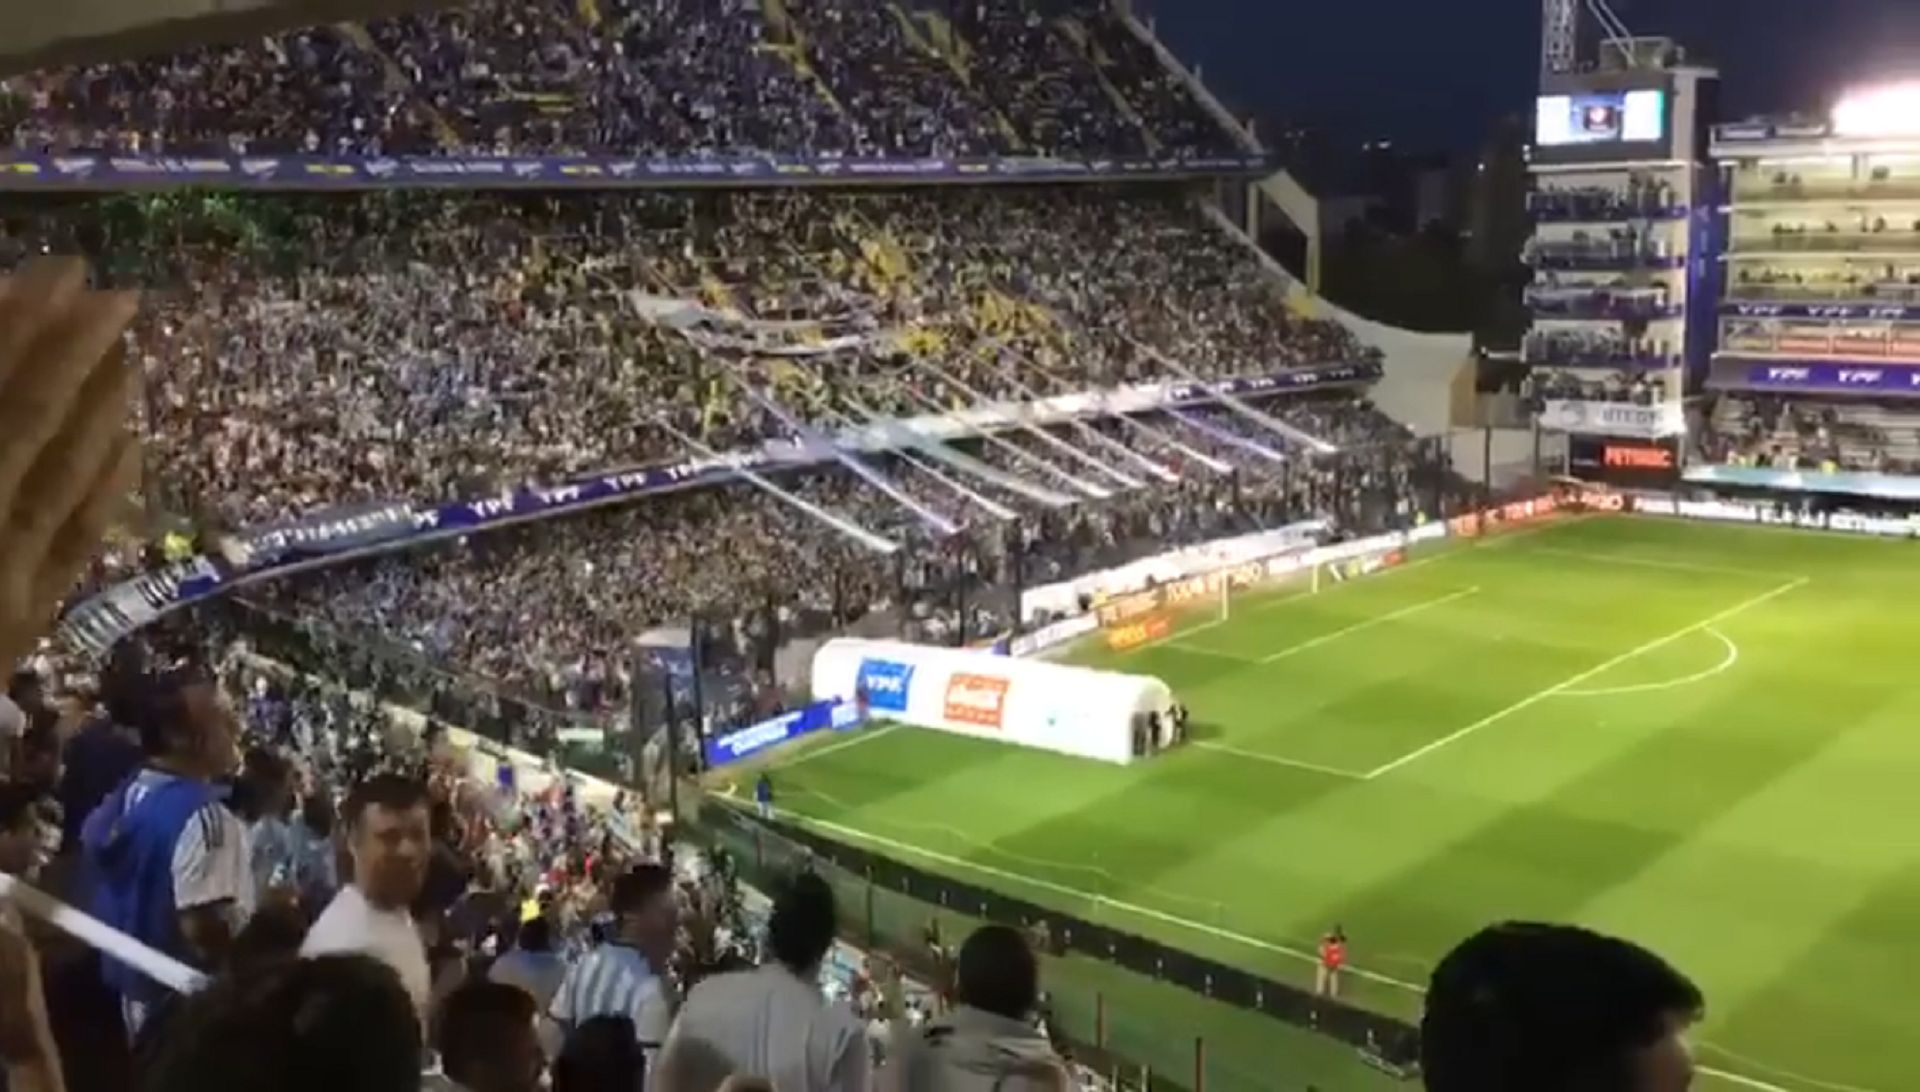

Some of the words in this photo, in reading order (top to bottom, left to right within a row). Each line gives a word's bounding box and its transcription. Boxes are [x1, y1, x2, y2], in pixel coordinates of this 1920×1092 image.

[1768, 367, 1810, 381] YPF
[1838, 369, 1882, 383] YPF
[866, 673, 905, 693] YPF
